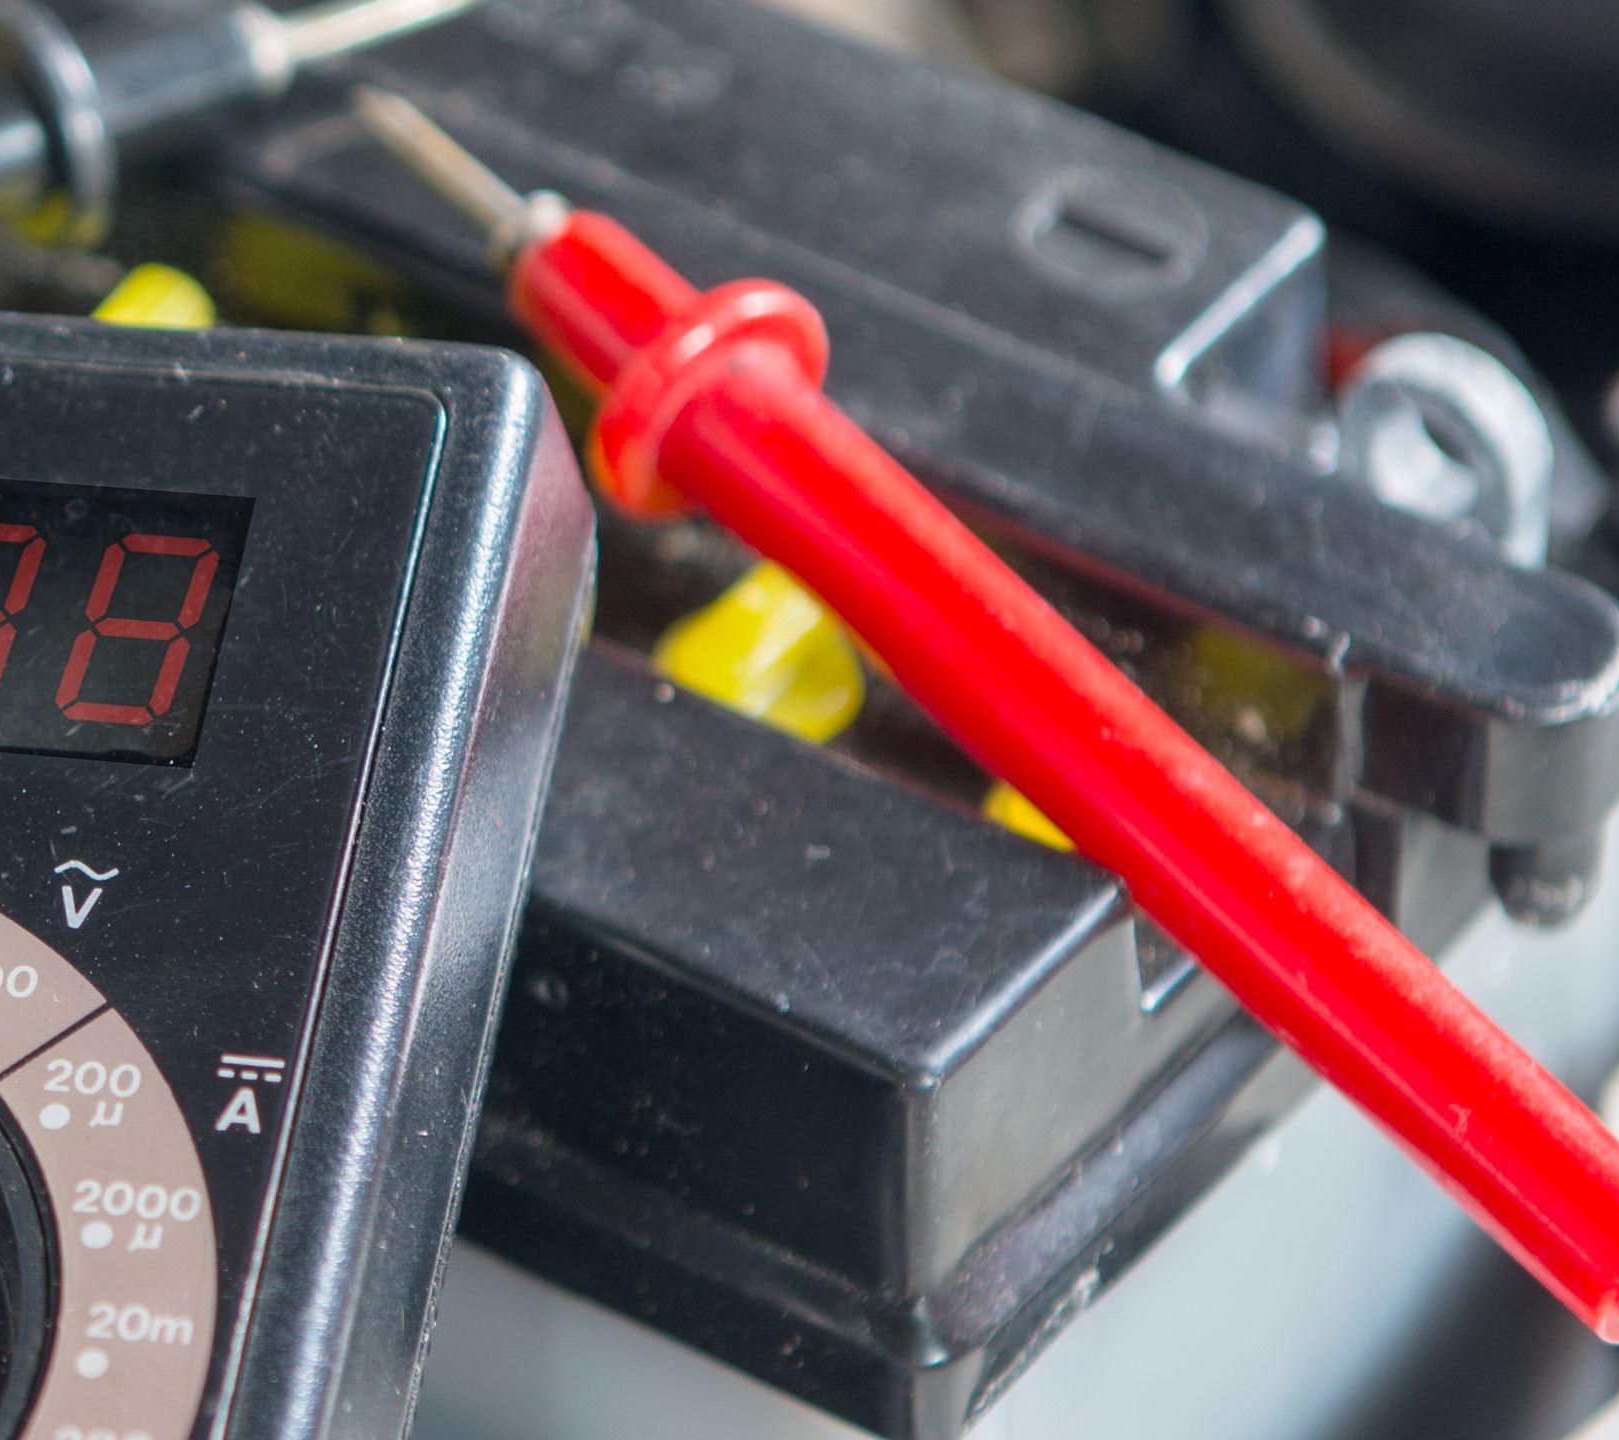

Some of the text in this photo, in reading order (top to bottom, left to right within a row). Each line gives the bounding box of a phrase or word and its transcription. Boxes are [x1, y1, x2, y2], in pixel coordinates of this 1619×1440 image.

[44, 1059, 141, 1097] 200
[73, 1180, 200, 1221] 2000
[87, 1303, 193, 1344] 20m
